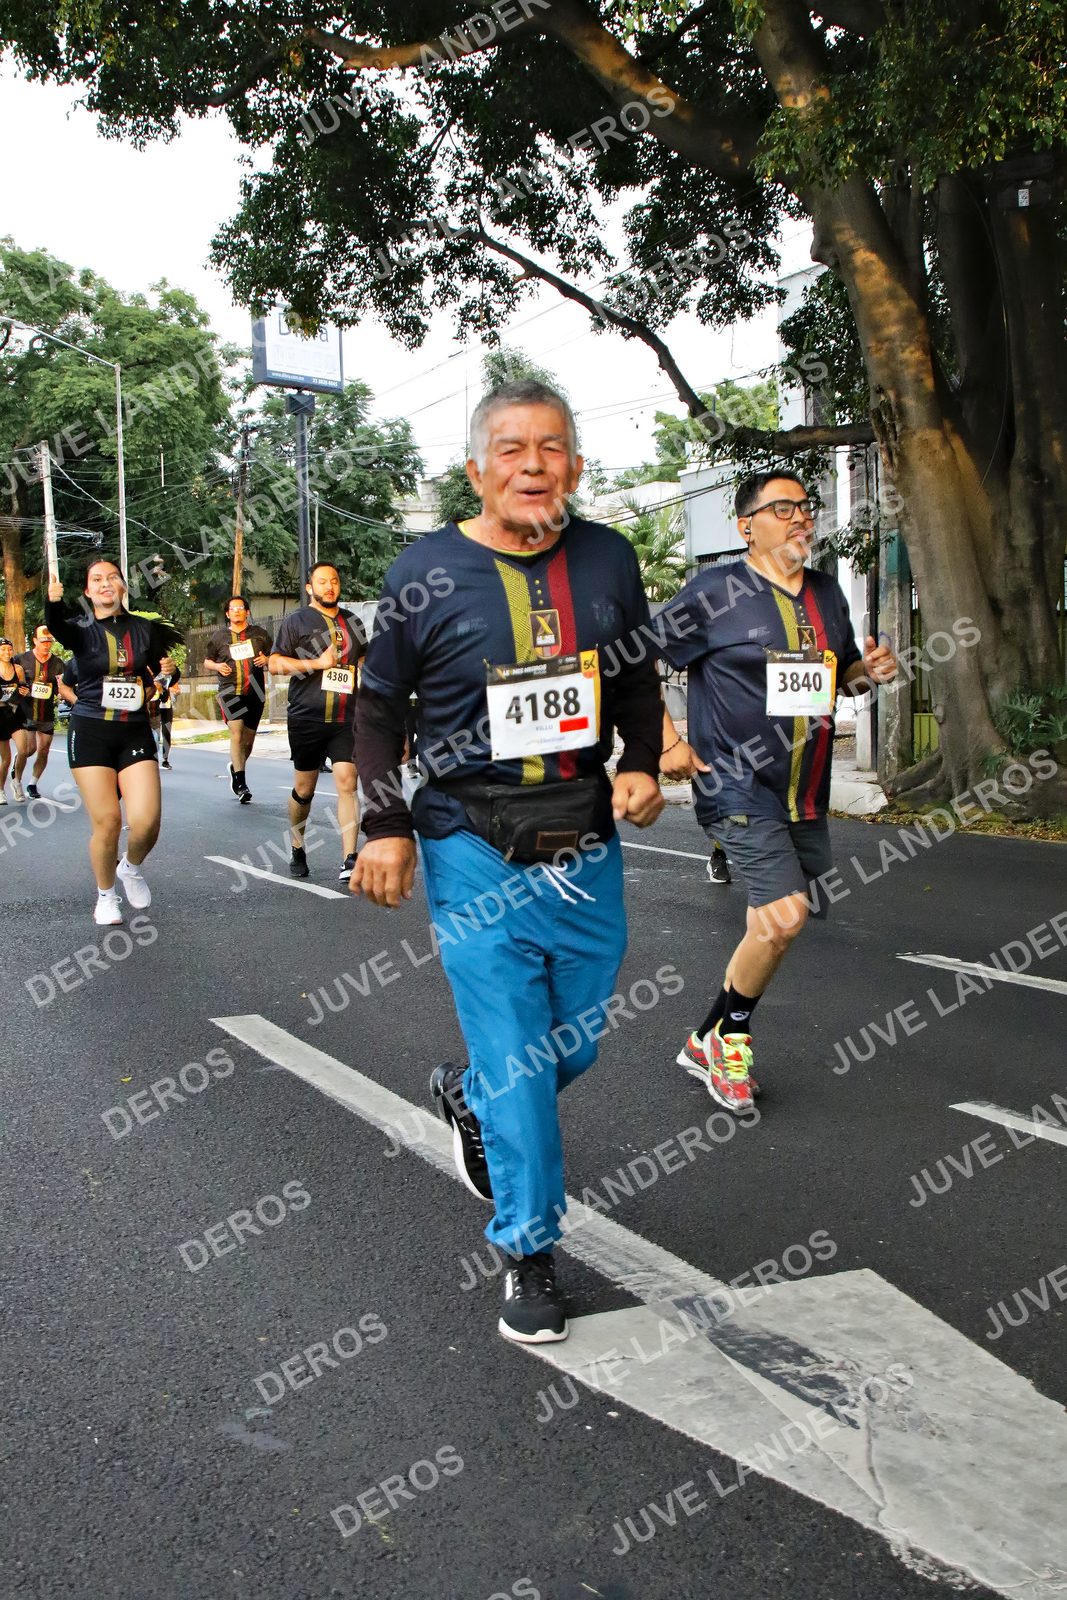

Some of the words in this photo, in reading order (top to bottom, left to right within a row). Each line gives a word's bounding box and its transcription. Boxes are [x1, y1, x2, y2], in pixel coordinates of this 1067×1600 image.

[326, 671, 349, 683] 4380
[778, 672, 822, 692] 3840
[108, 687, 136, 699] 4522
[506, 687, 581, 724] 4188
